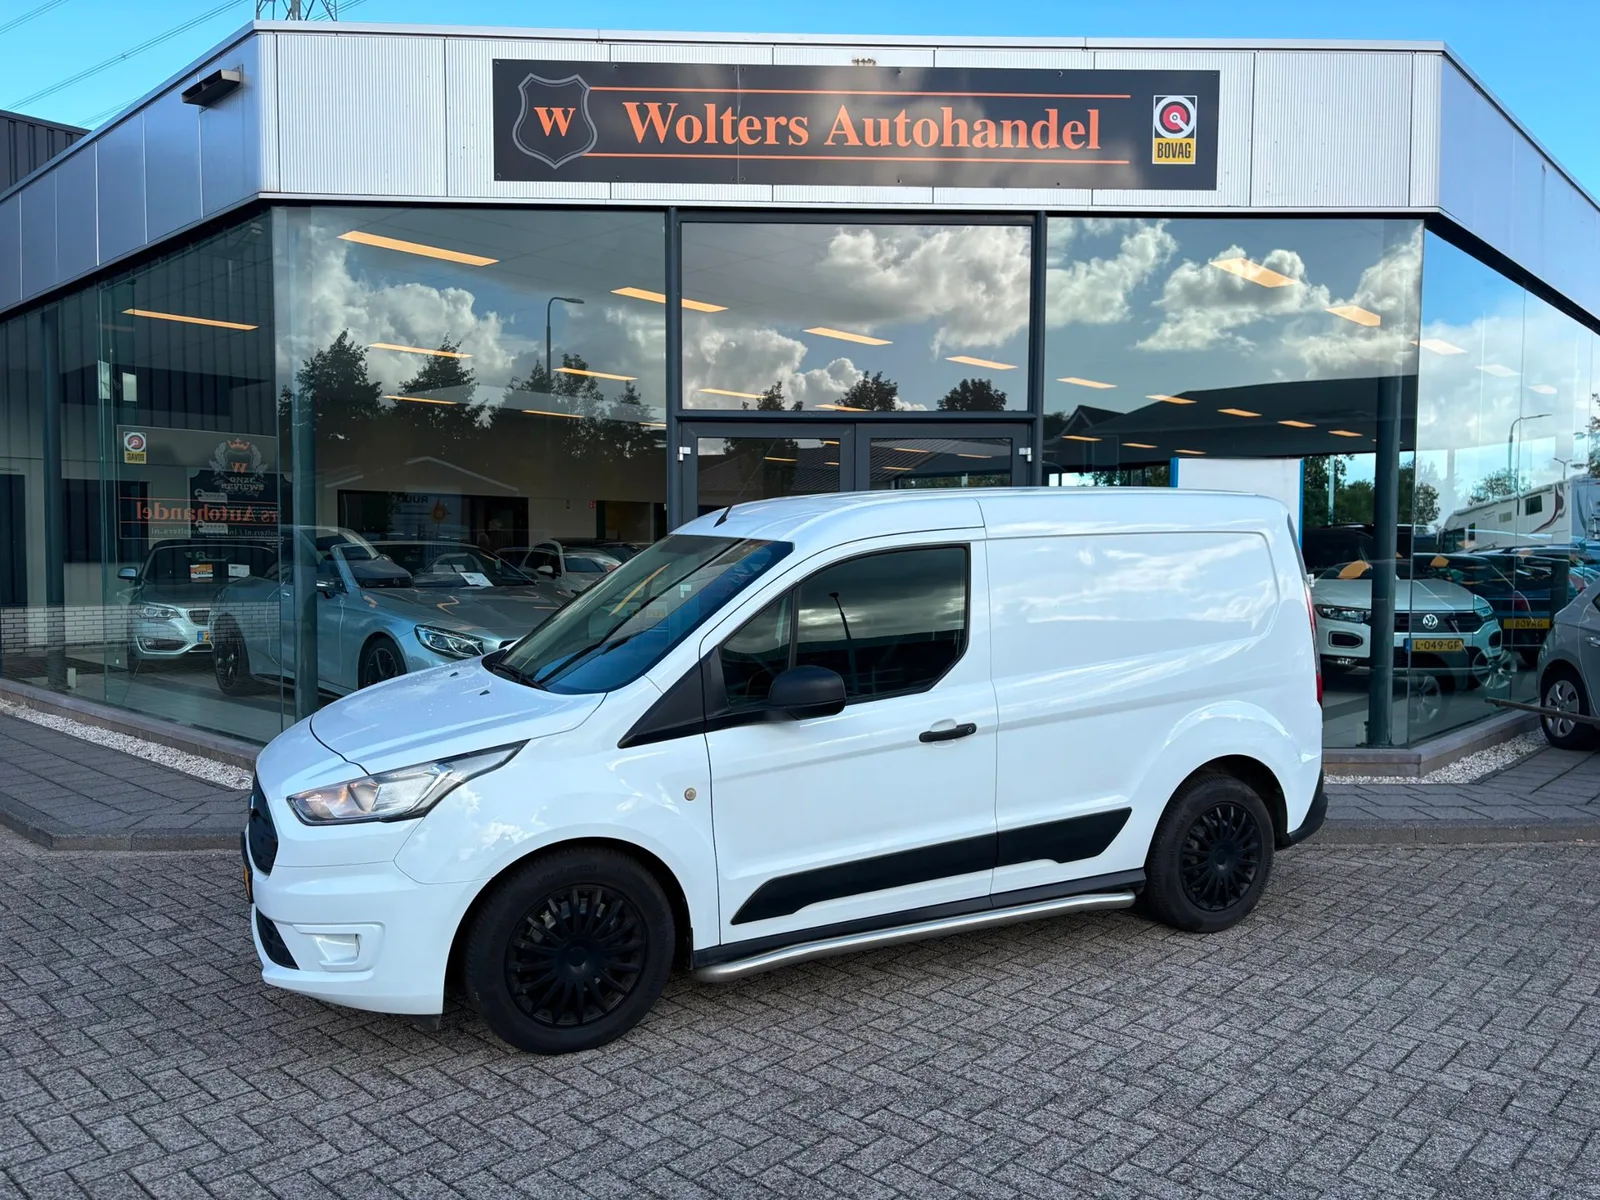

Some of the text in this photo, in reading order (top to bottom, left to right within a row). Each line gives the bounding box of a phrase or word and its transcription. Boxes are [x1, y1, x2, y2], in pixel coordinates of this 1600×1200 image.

[534, 106, 576, 137] W
[622, 102, 1101, 150] Wolters Autohandel
[1157, 142, 1191, 159] BOVAG
[1515, 619, 1544, 628] BOVAG
[1415, 640, 1460, 650] L-049-GF
